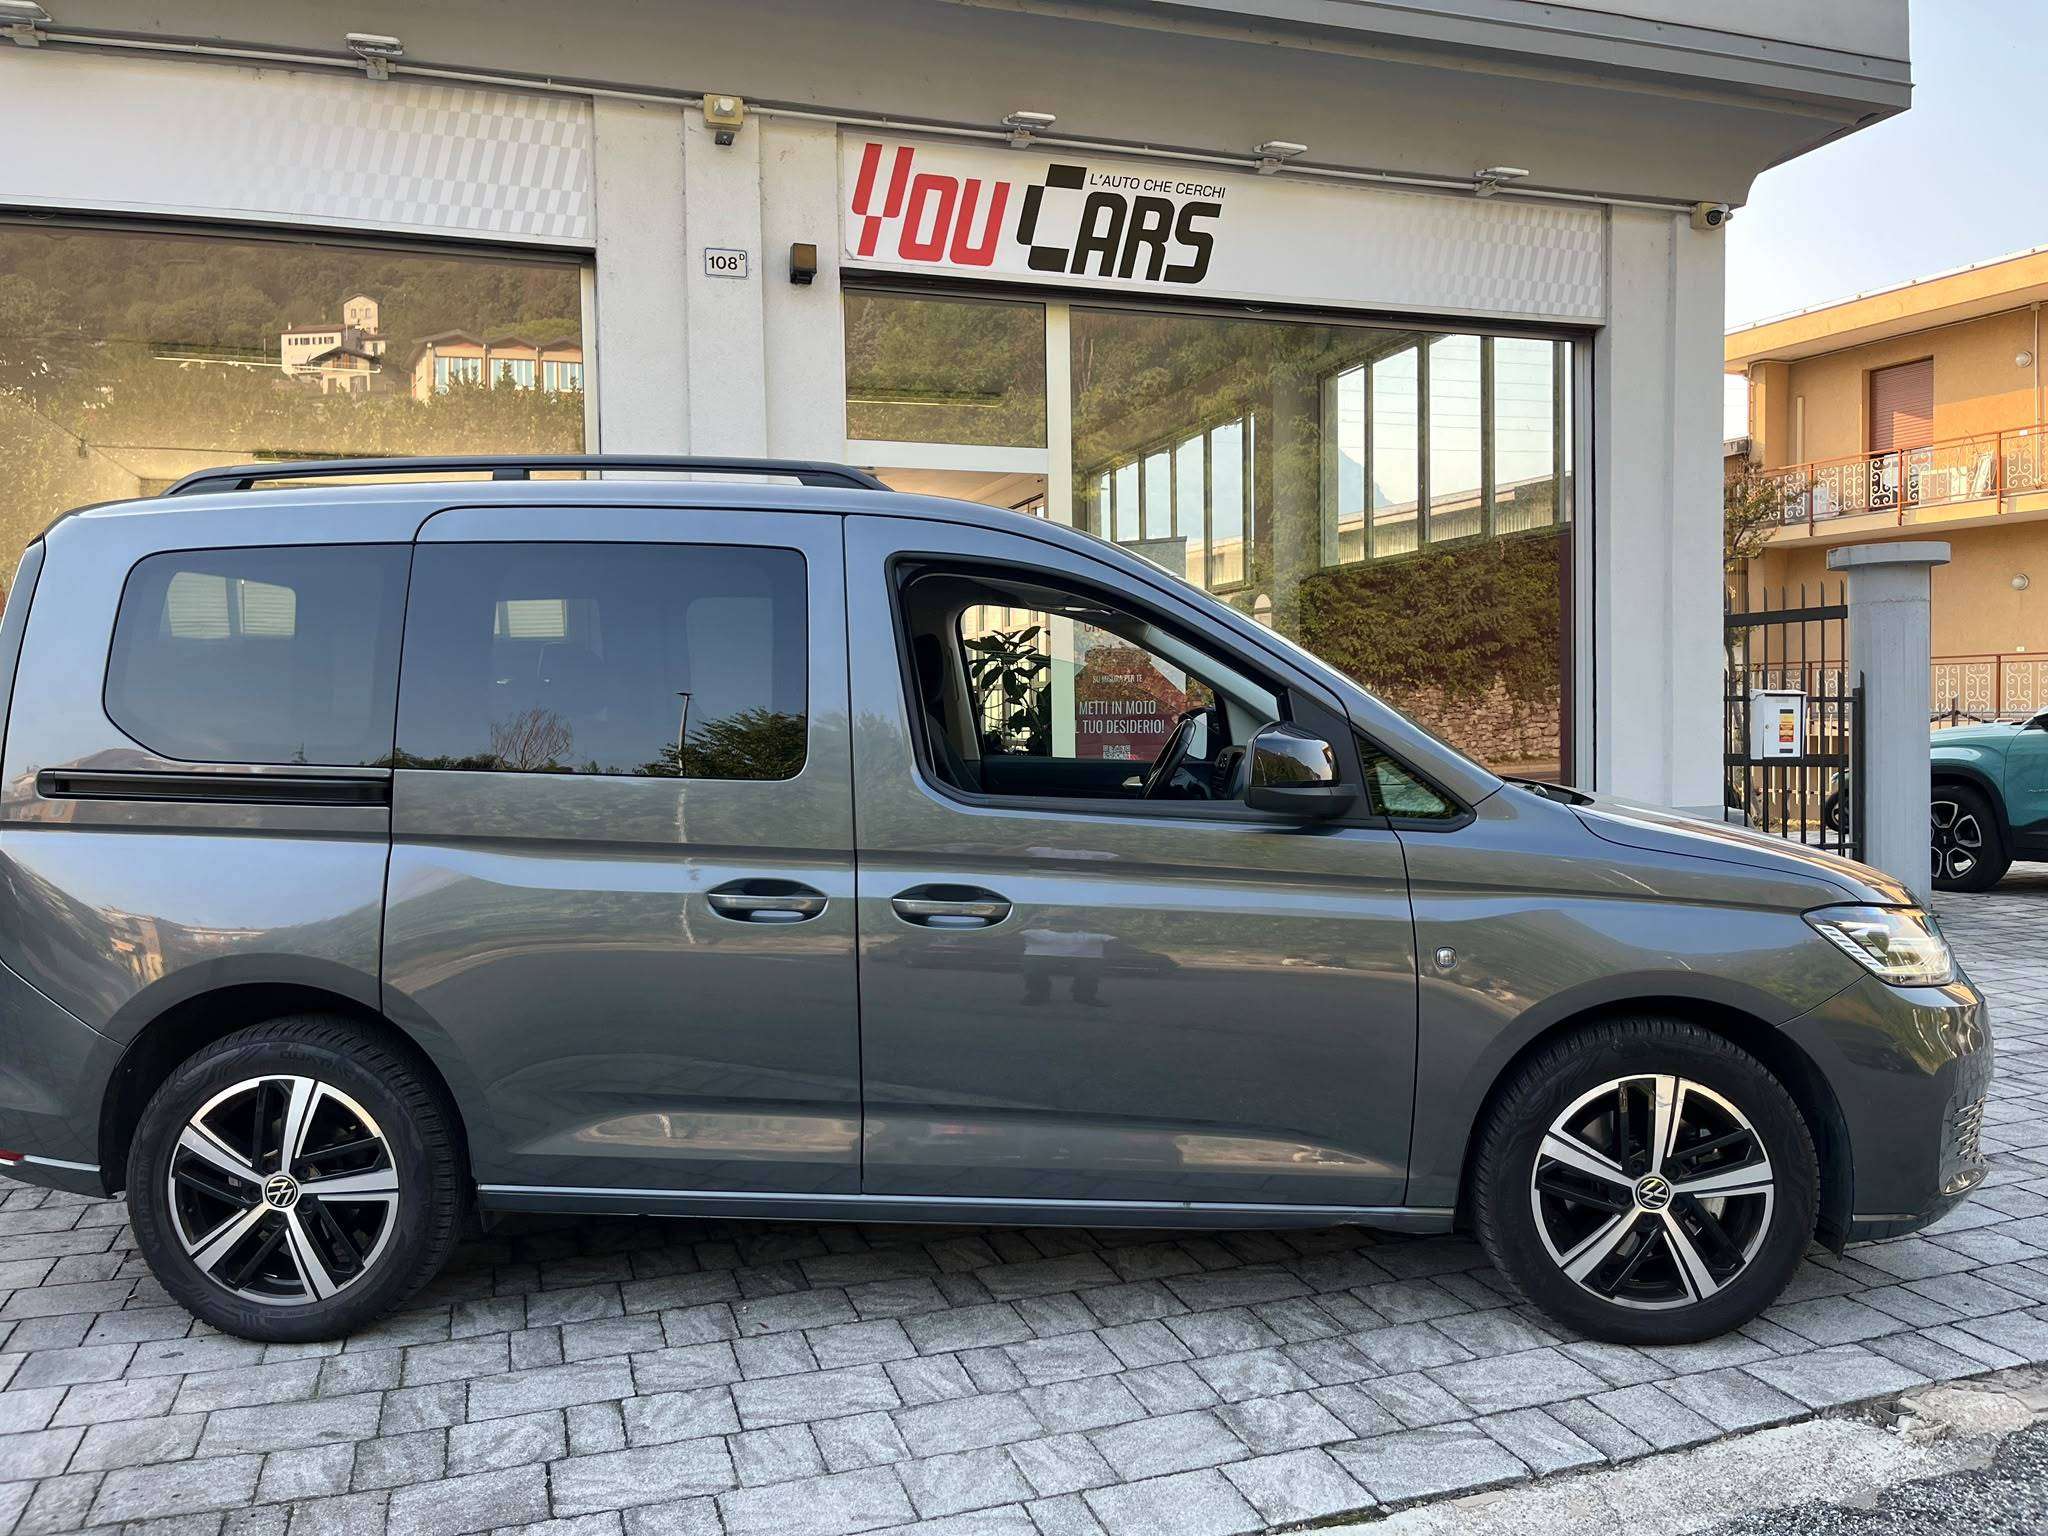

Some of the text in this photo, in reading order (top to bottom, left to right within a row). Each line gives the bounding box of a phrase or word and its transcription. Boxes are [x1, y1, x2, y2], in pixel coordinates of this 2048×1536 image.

[1089, 173, 1226, 199] L'AUTO CHE CERCHI
[852, 143, 1222, 284] YOU CARS
[1079, 700, 1156, 715] METTI IN MOTO
[1083, 719, 1103, 734] TUO
[1106, 719, 1165, 734] DESIDERIO!
